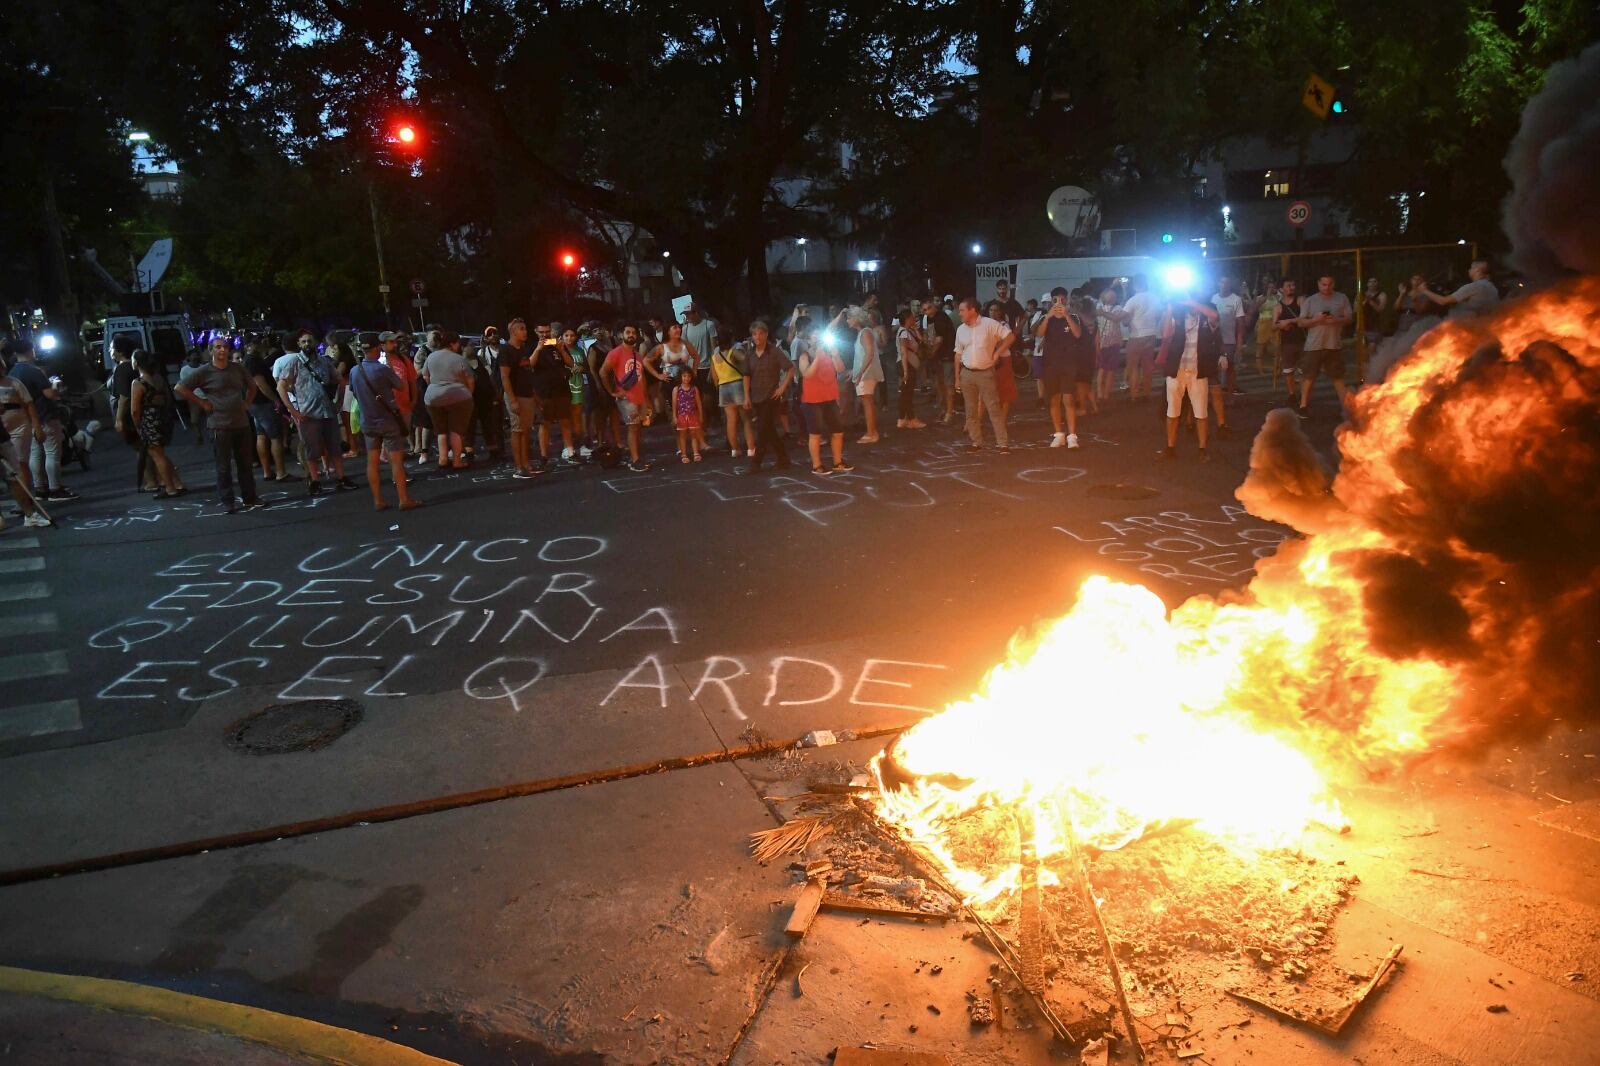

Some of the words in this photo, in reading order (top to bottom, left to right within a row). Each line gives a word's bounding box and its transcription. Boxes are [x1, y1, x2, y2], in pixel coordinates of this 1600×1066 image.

[1290, 207, 1307, 220] 30
[976, 266, 1008, 278] VISION
[155, 551, 255, 577] EL
[97, 656, 270, 702] ES
[277, 654, 416, 701] EL
[463, 656, 548, 712] Q
[600, 654, 947, 721] ARDE
